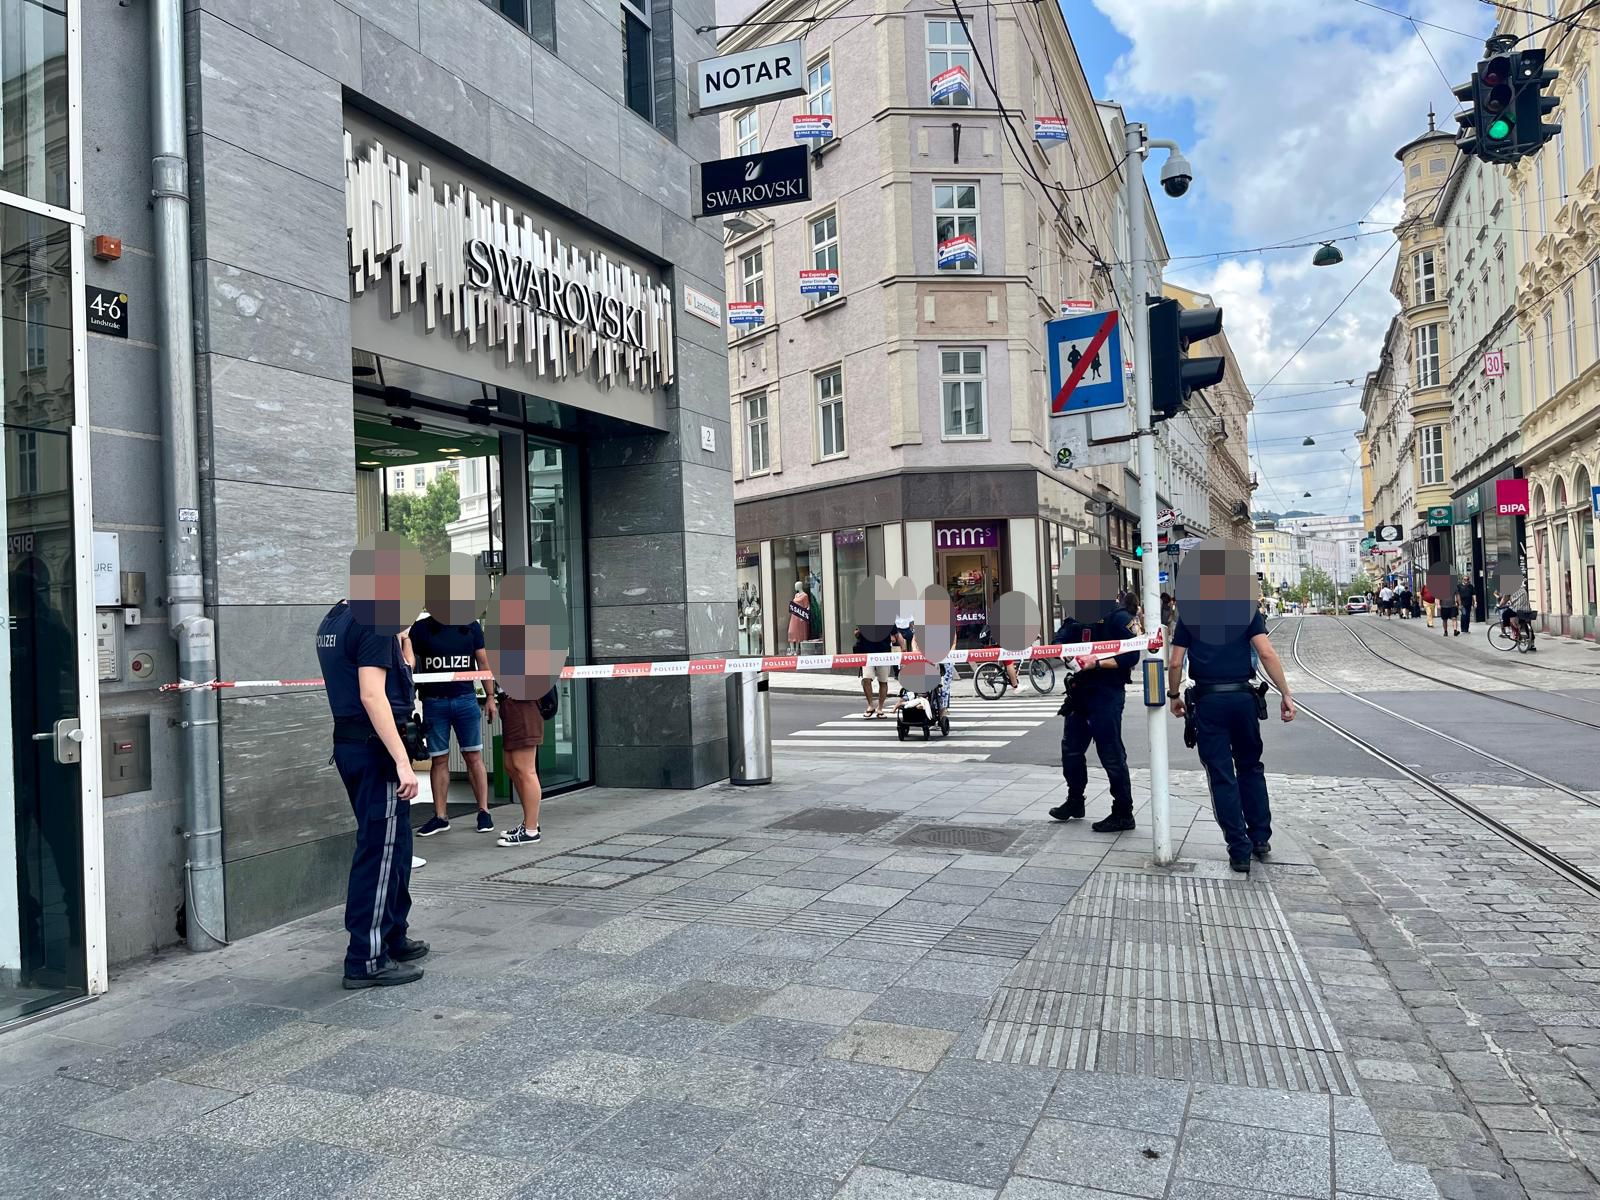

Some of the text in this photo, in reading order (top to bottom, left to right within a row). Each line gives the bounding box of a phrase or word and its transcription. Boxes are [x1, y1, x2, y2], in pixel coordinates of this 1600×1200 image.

[705, 56, 793, 94] NOTAR
[706, 178, 804, 209] SWAROVSKI
[467, 238, 647, 350] SWAROVSKI
[90, 293, 120, 319] 4-6
[90, 316, 121, 330] Landstraße
[1487, 356, 1500, 372] 30
[1499, 503, 1527, 513] BIPA
[425, 655, 471, 669] POLIZEI
